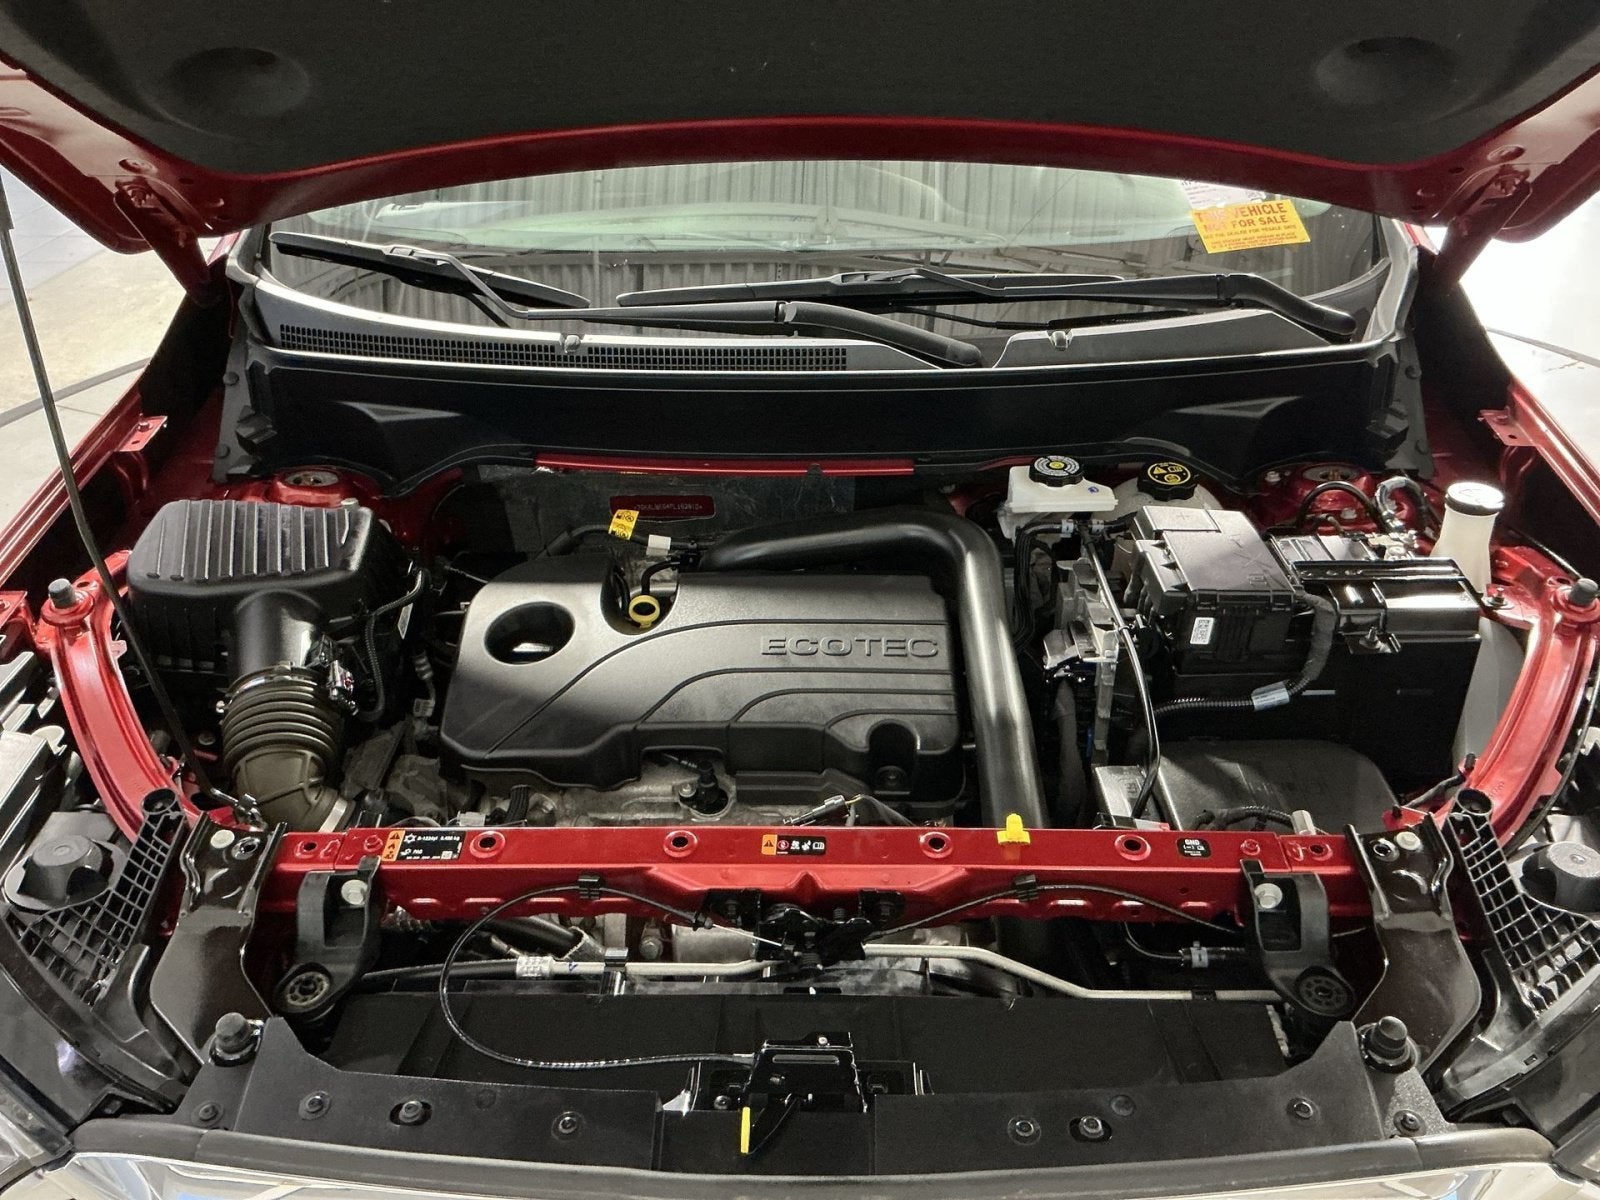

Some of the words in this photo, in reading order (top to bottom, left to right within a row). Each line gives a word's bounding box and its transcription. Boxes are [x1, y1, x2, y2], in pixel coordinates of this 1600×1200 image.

[1232, 203, 1288, 218] VEHICLE
[1231, 219, 1255, 228] FOR
[1259, 215, 1289, 225] SALE
[760, 635, 939, 658] ECOTEC
